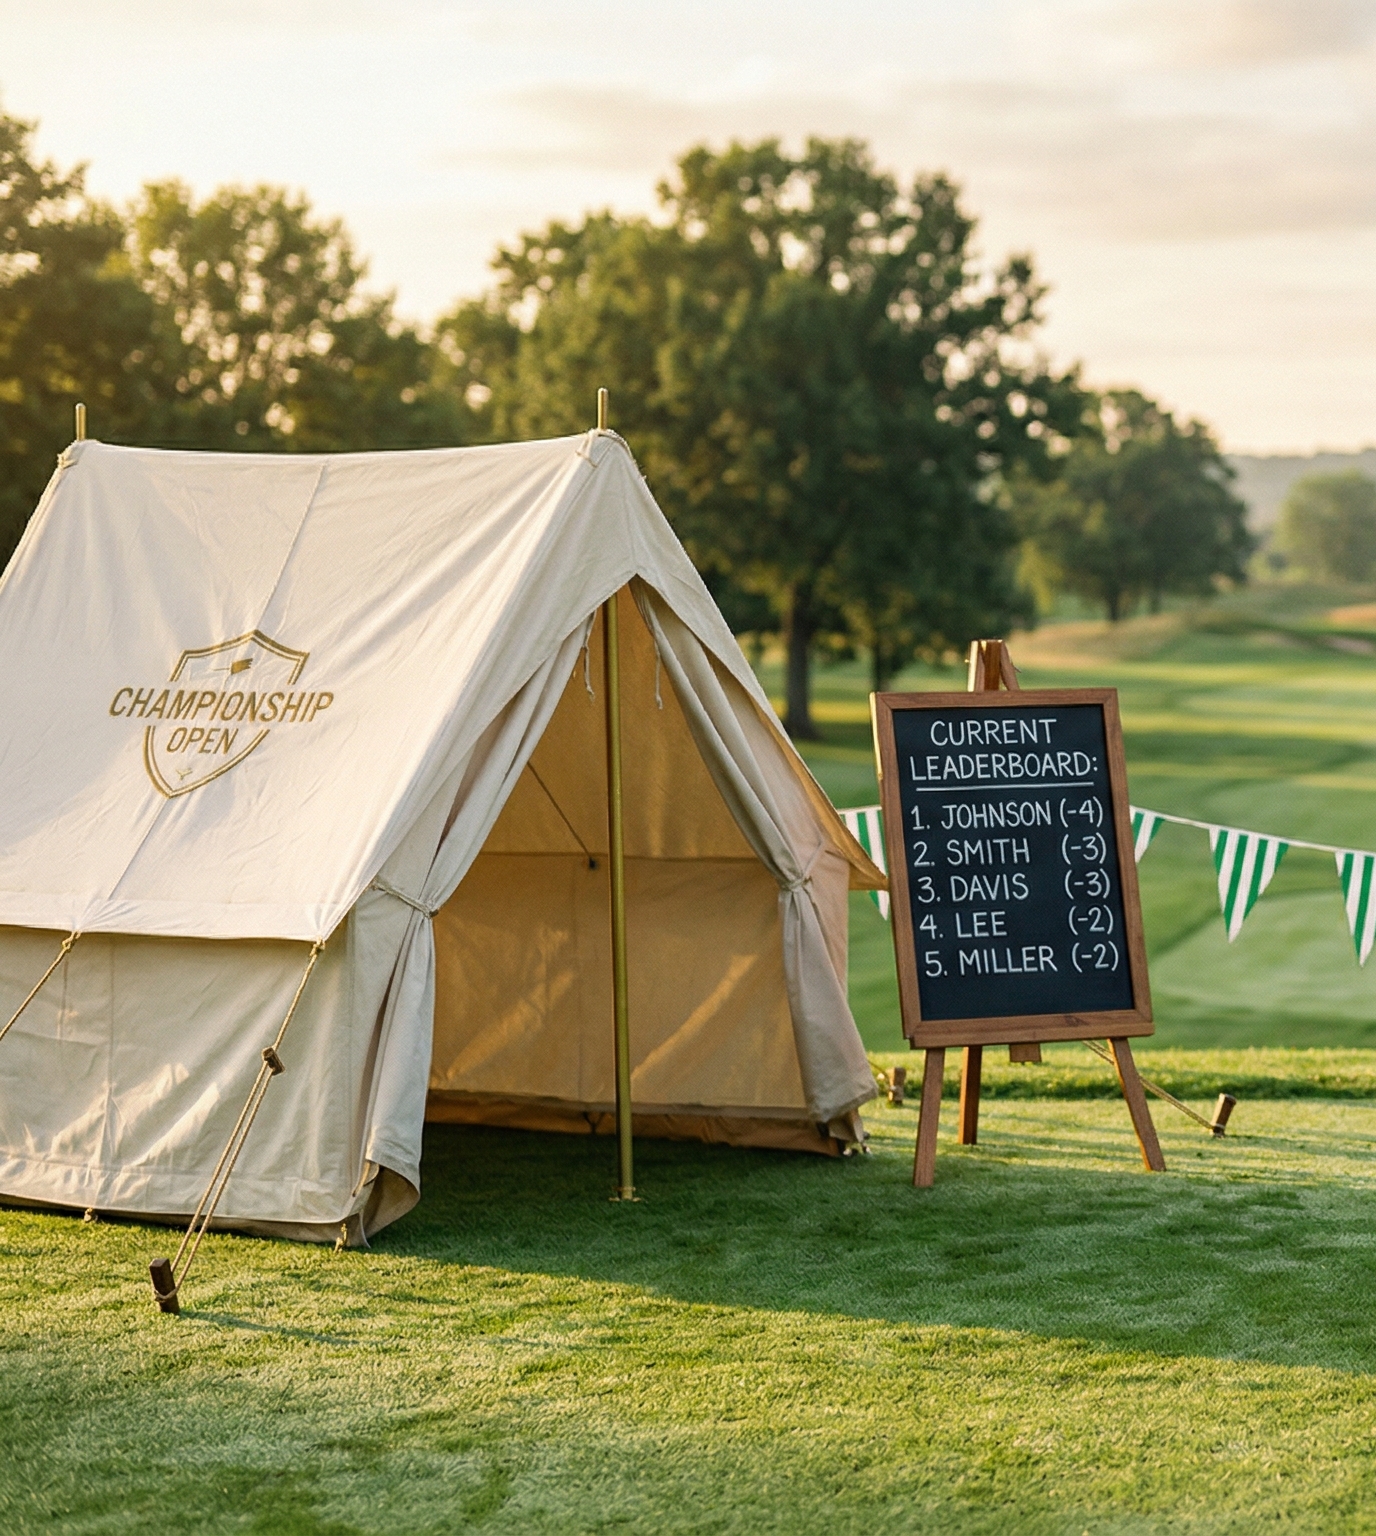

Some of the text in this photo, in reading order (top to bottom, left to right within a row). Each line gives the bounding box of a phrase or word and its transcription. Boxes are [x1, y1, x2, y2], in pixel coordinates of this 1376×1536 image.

[109, 687, 334, 723] CHAMPIONSHIP
[166, 726, 238, 754] OPEN
[930, 718, 1057, 746] CURRENT
[909, 751, 1098, 781] LEADERBOARD:
[911, 796, 1103, 830] 1. JOHNSON (-4)
[913, 832, 1107, 867] 2. SMITH (-3)
[917, 868, 1111, 904] 3. DAVIS (-3)
[919, 904, 1114, 939] 4. LEE (-2)
[925, 940, 1119, 978] 5. MILLER (-2)
